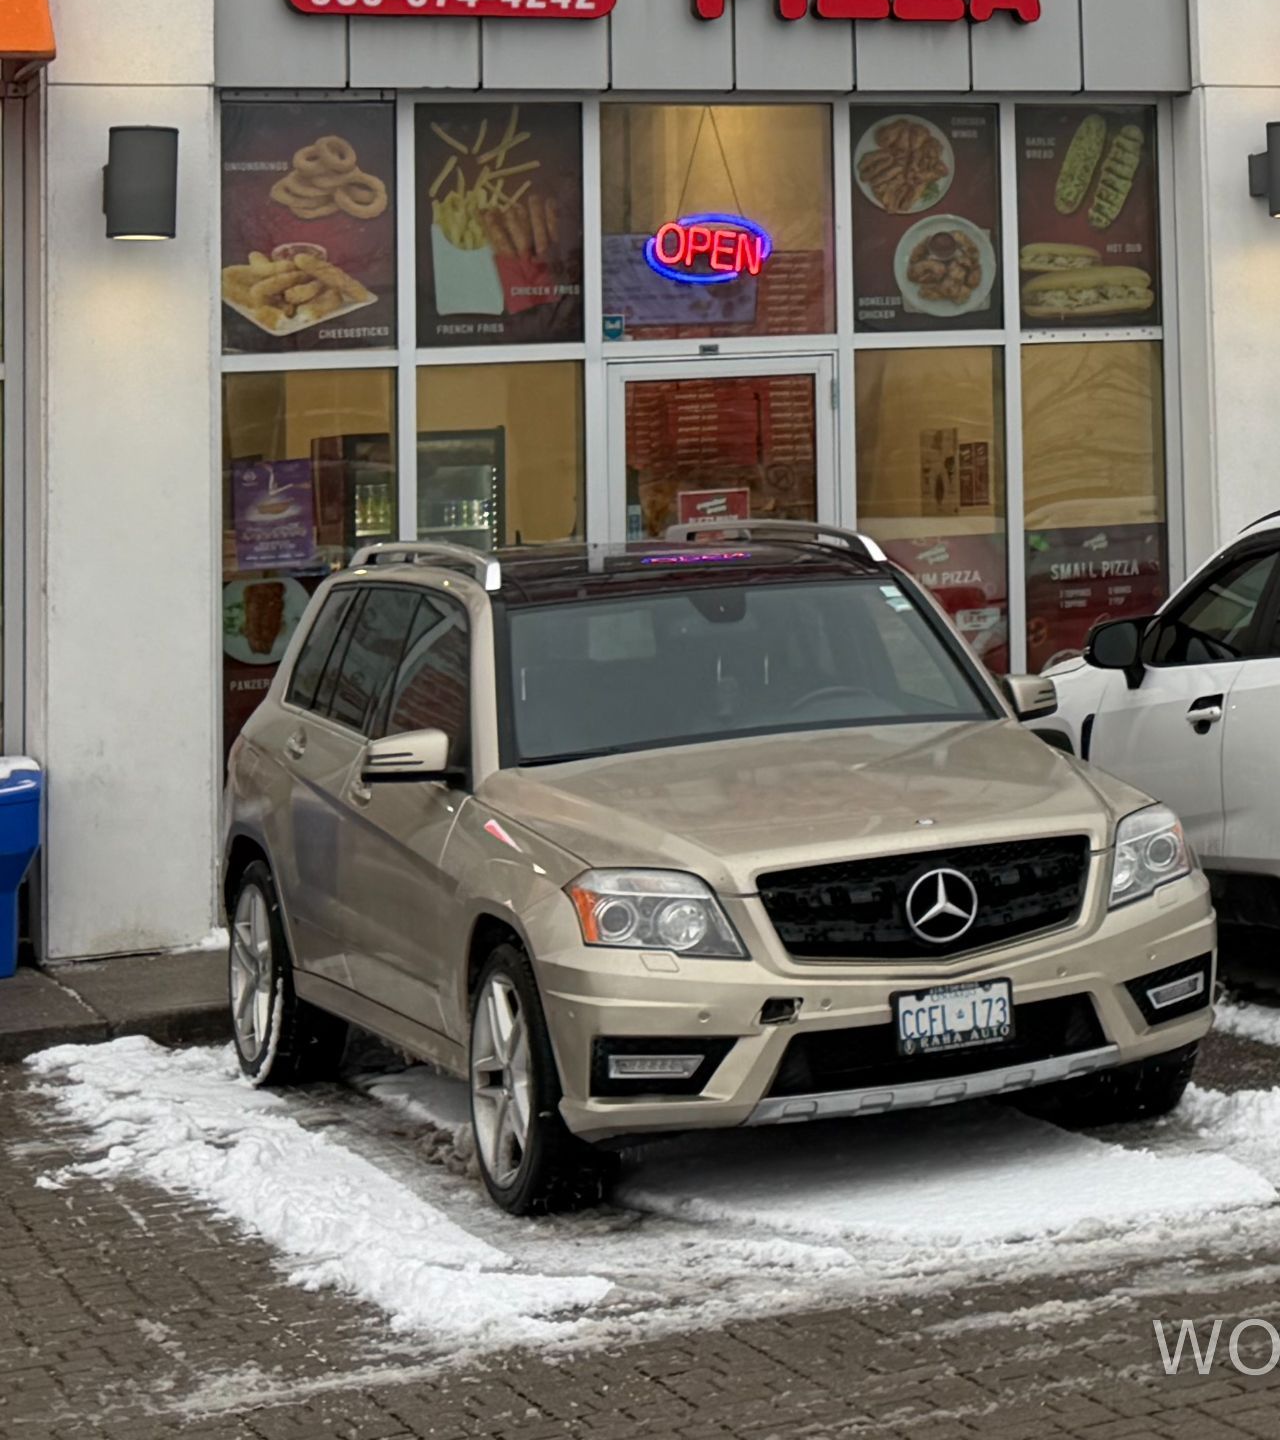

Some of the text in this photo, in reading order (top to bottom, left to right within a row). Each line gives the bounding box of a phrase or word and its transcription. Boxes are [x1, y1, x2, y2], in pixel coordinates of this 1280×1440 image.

[656, 223, 762, 275] OPEN
[318, 326, 389, 340] CHEESESTICKS
[437, 323, 504, 335] FRENCH FRIES
[1050, 559, 1140, 580] SMALL PIZZA
[941, 570, 982, 584] PIZZA
[230, 679, 272, 691] PANZER
[902, 997, 1007, 1040] CCFL 173
[970, 1025, 1010, 1040] AUTO
